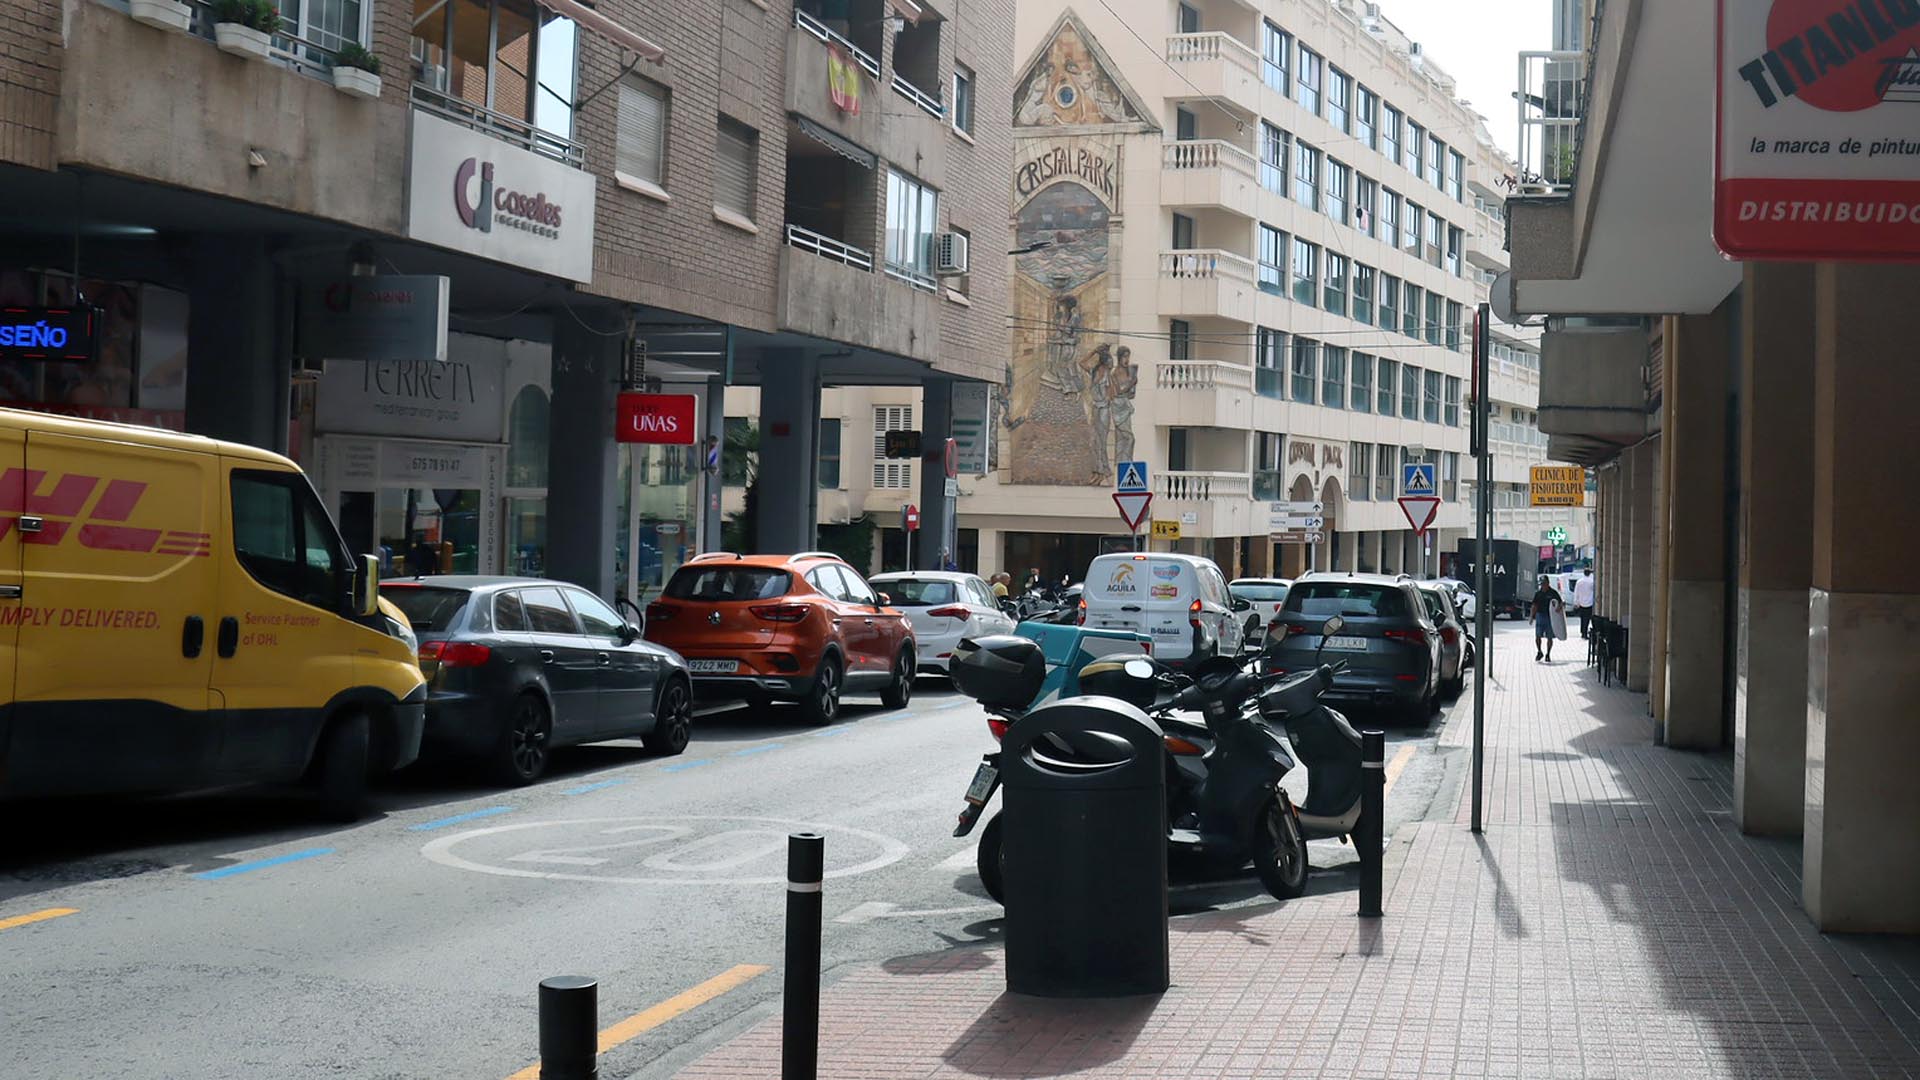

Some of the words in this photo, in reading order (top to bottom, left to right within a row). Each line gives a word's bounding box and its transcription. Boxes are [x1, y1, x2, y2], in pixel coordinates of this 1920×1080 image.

[1750, 137, 1766, 153] la
[1773, 140, 1830, 154] marca
[1839, 138, 1861, 154] de
[633, 413, 678, 432] UÑAS
[0, 607, 56, 626] MPLY
[245, 612, 281, 626] Service
[284, 613, 321, 627] Partner
[242, 633, 255, 646] of
[257, 633, 278, 646] DHL
[690, 660, 715, 671] 9242
